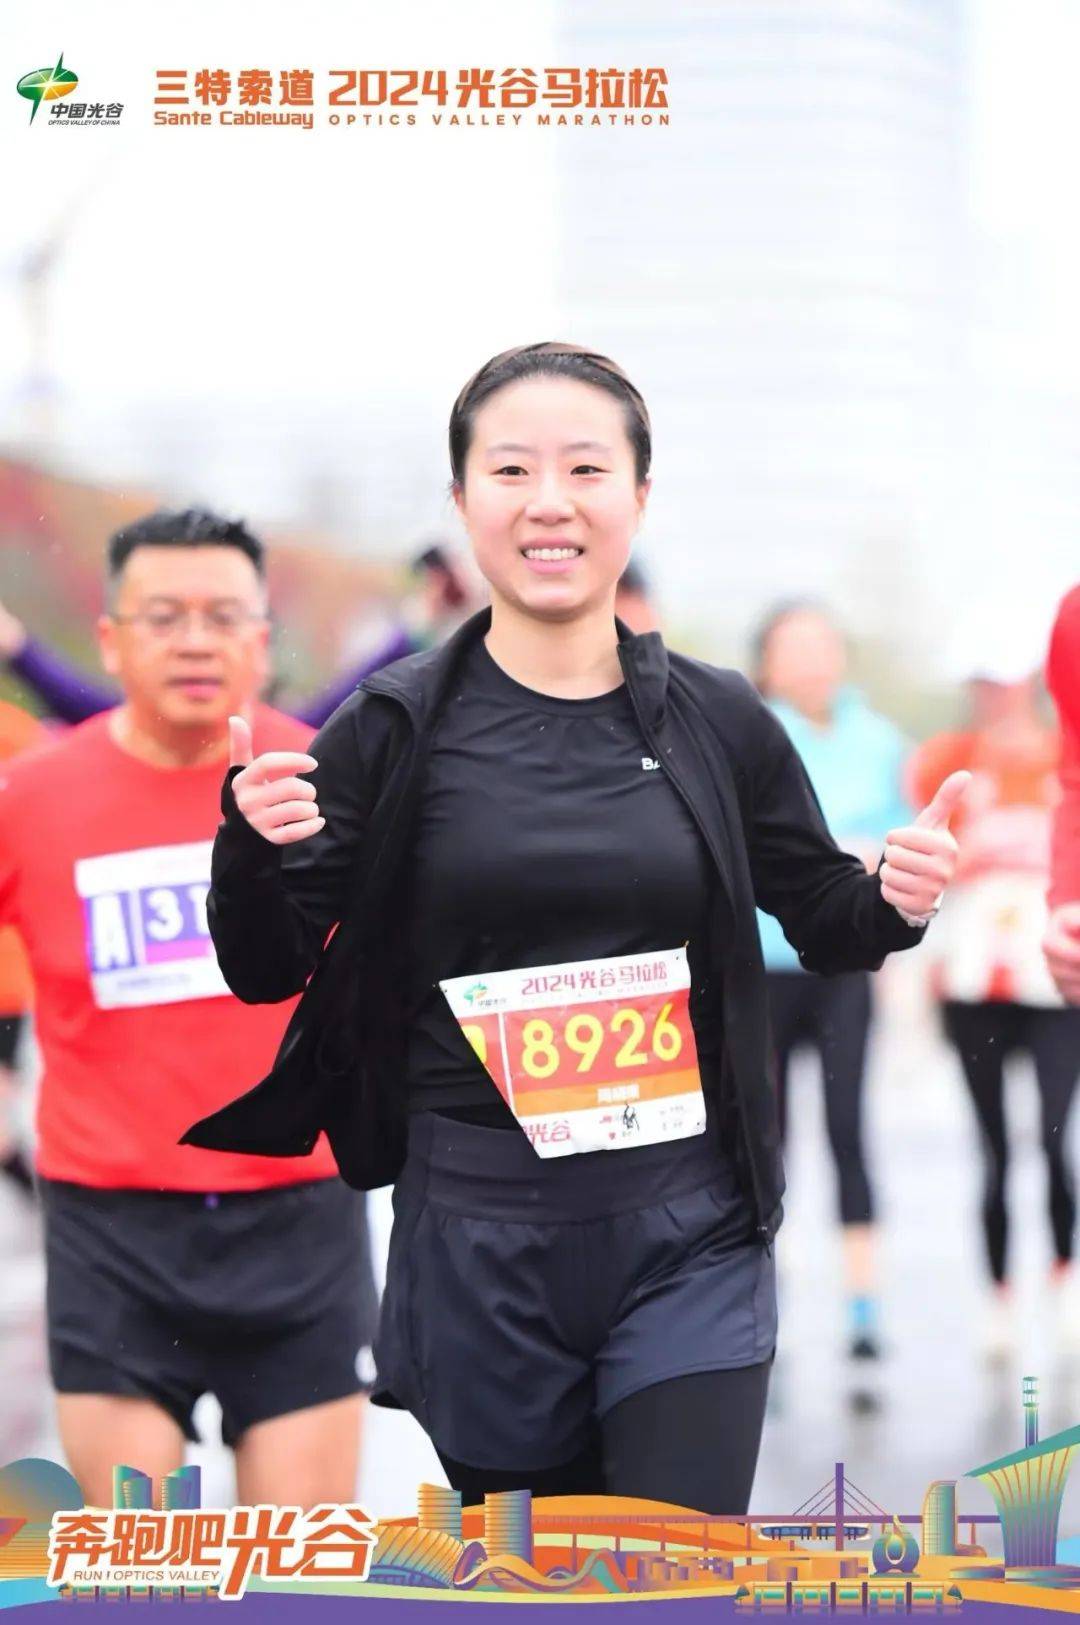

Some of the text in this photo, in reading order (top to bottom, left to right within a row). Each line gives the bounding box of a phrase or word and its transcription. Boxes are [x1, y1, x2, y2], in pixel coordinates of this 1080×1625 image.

[521, 961, 668, 996] 2024光谷马拉松
[522, 1003, 682, 1078] 8926
[524, 1119, 571, 1146] 光谷
